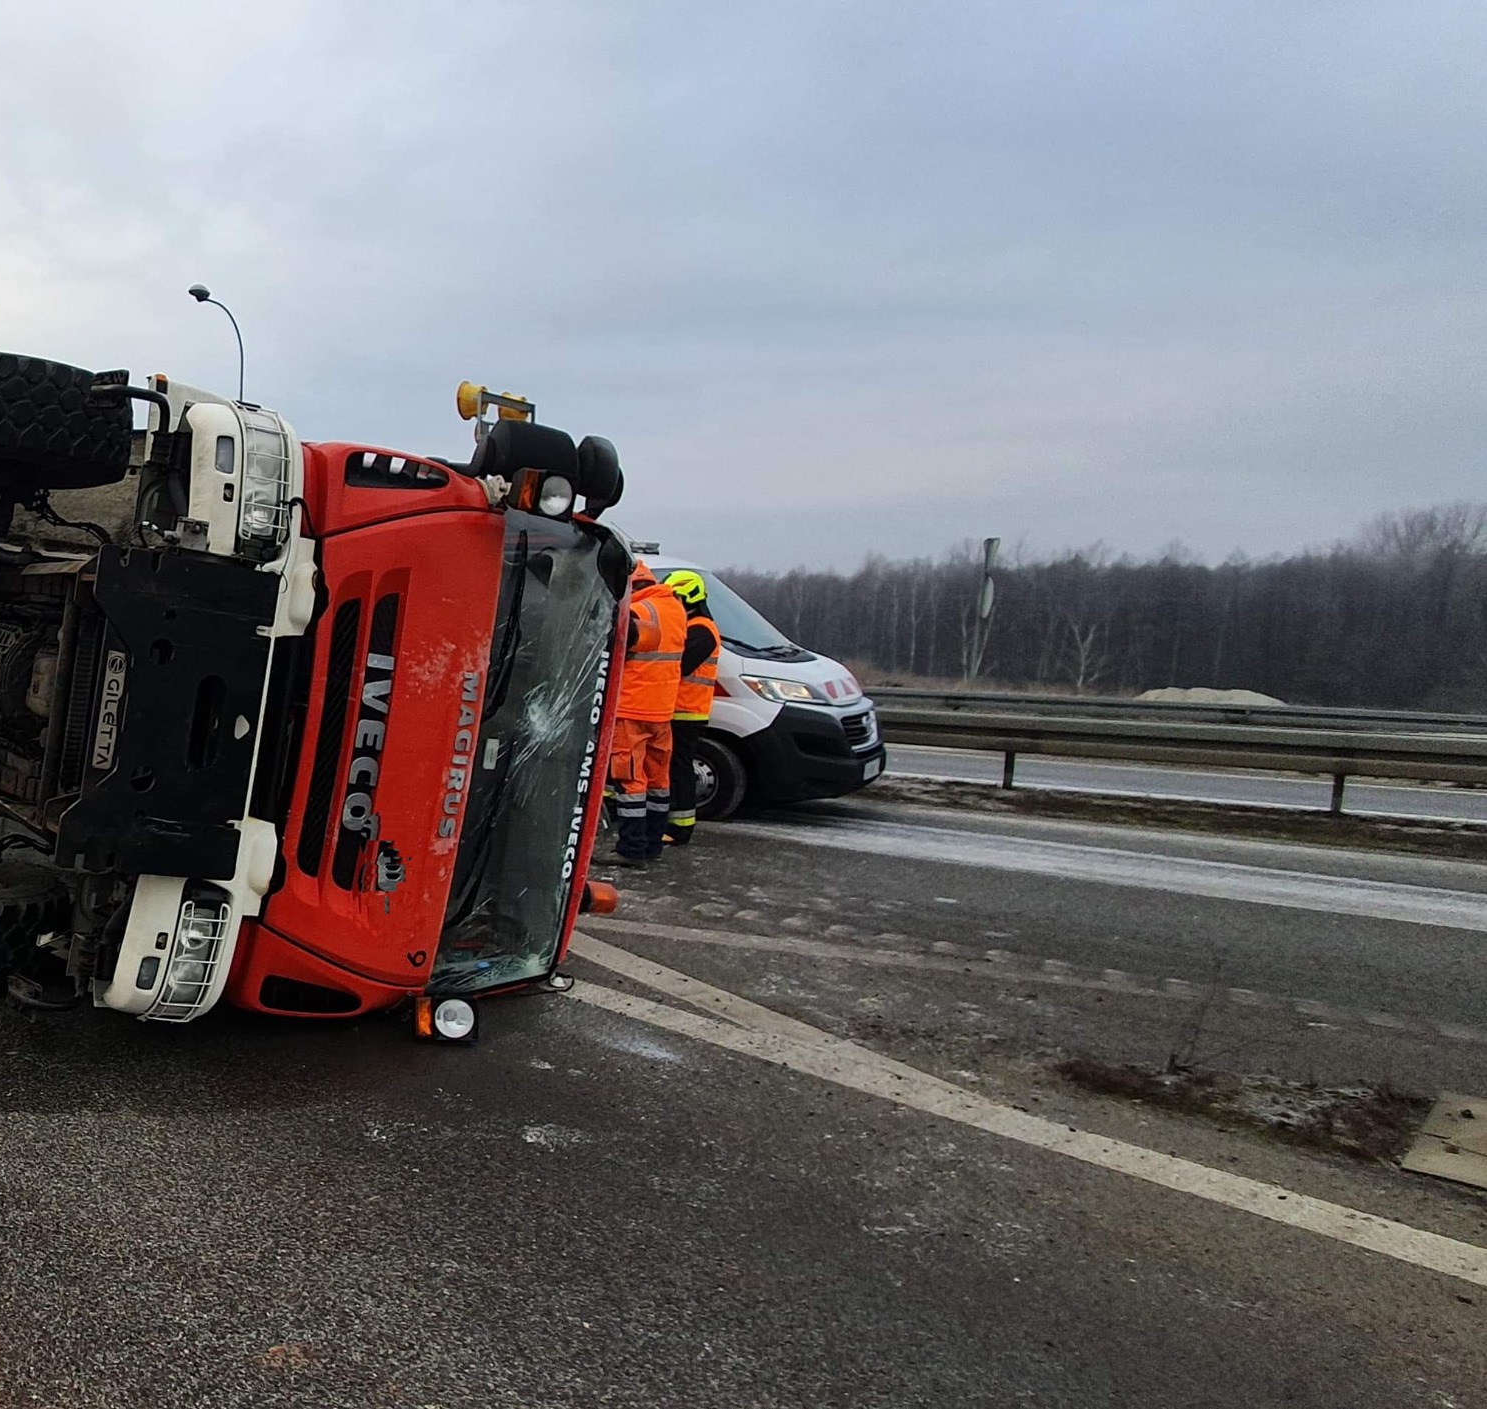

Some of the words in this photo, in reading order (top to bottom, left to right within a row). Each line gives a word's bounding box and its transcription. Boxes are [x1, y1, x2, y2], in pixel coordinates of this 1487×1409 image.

[590, 651, 610, 725] IVECO
[342, 653, 395, 831] IVECO
[438, 672, 480, 839] MAGIRUS
[577, 741, 595, 793] AMS
[562, 807, 583, 879] IVECO
